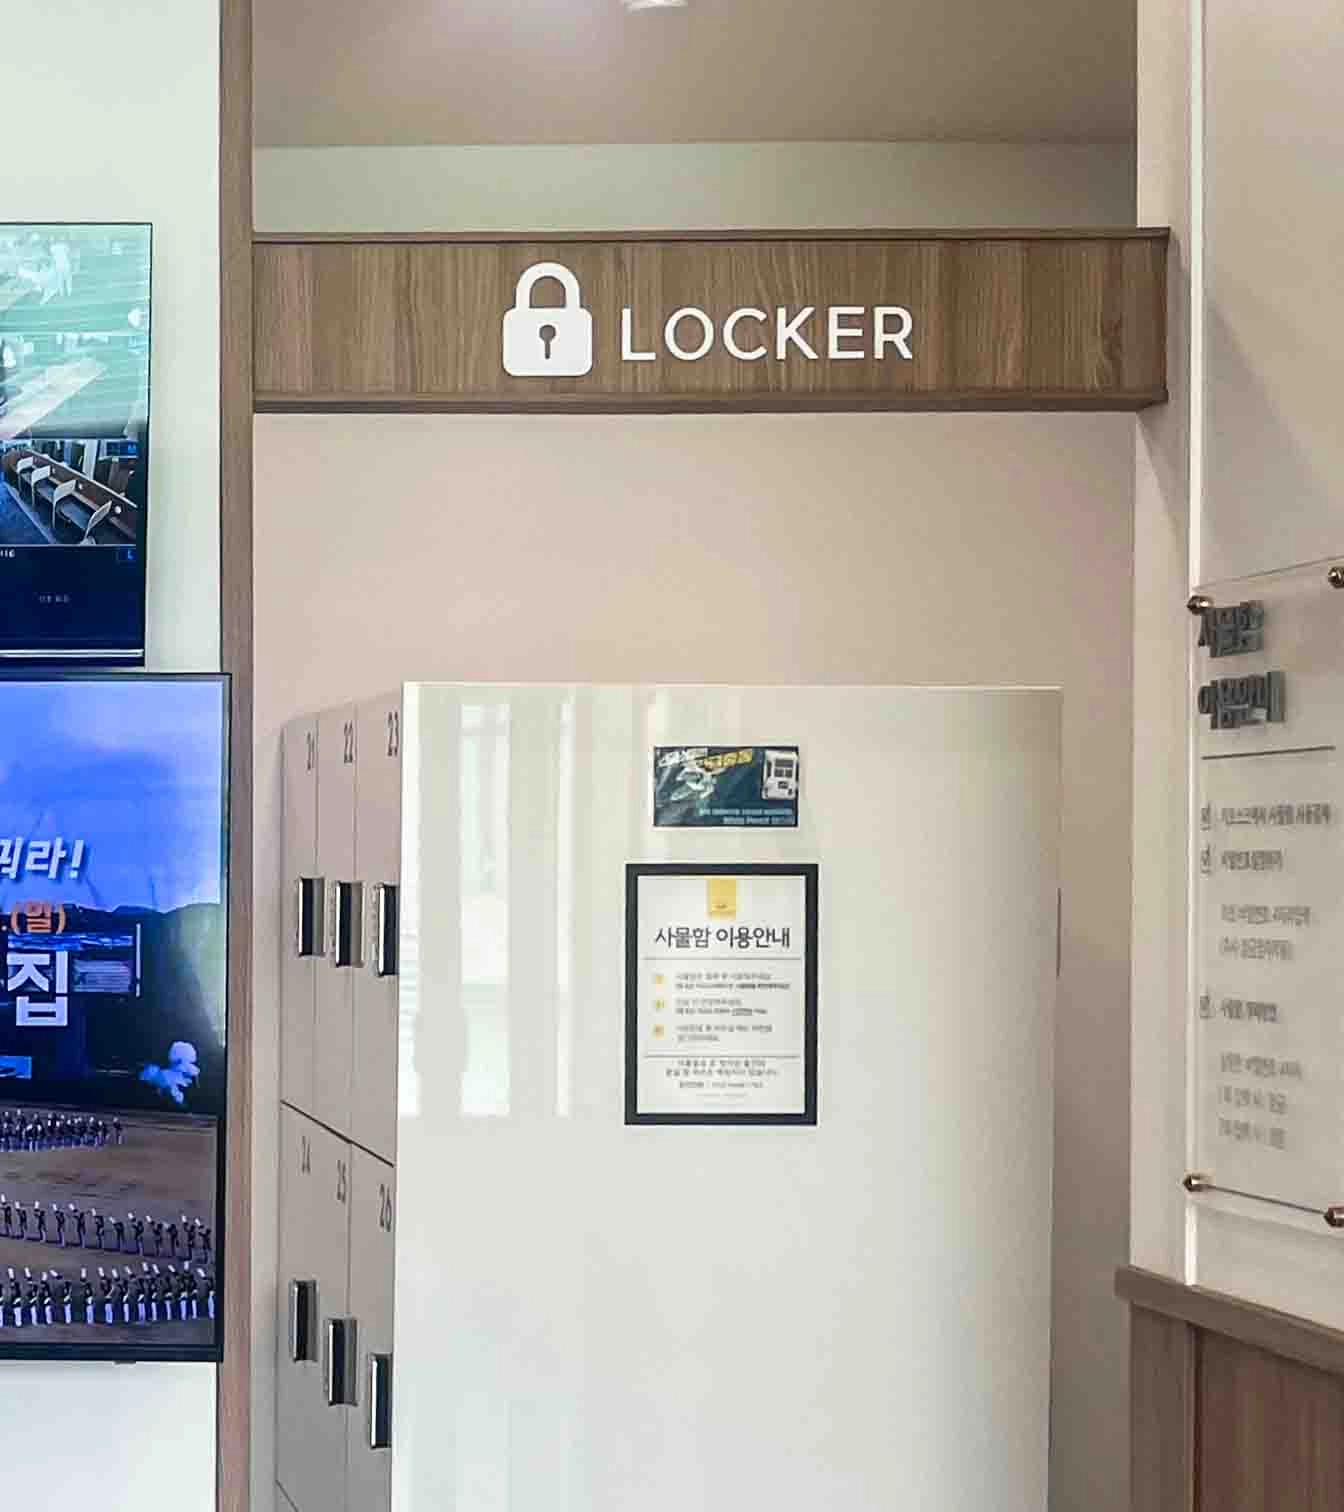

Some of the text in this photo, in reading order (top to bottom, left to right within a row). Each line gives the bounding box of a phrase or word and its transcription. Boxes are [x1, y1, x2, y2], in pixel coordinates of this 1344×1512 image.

[620, 305, 914, 362] LOCKER
[655, 926, 791, 949] 사물함 이용안내
[378, 1183, 392, 1232] 26
